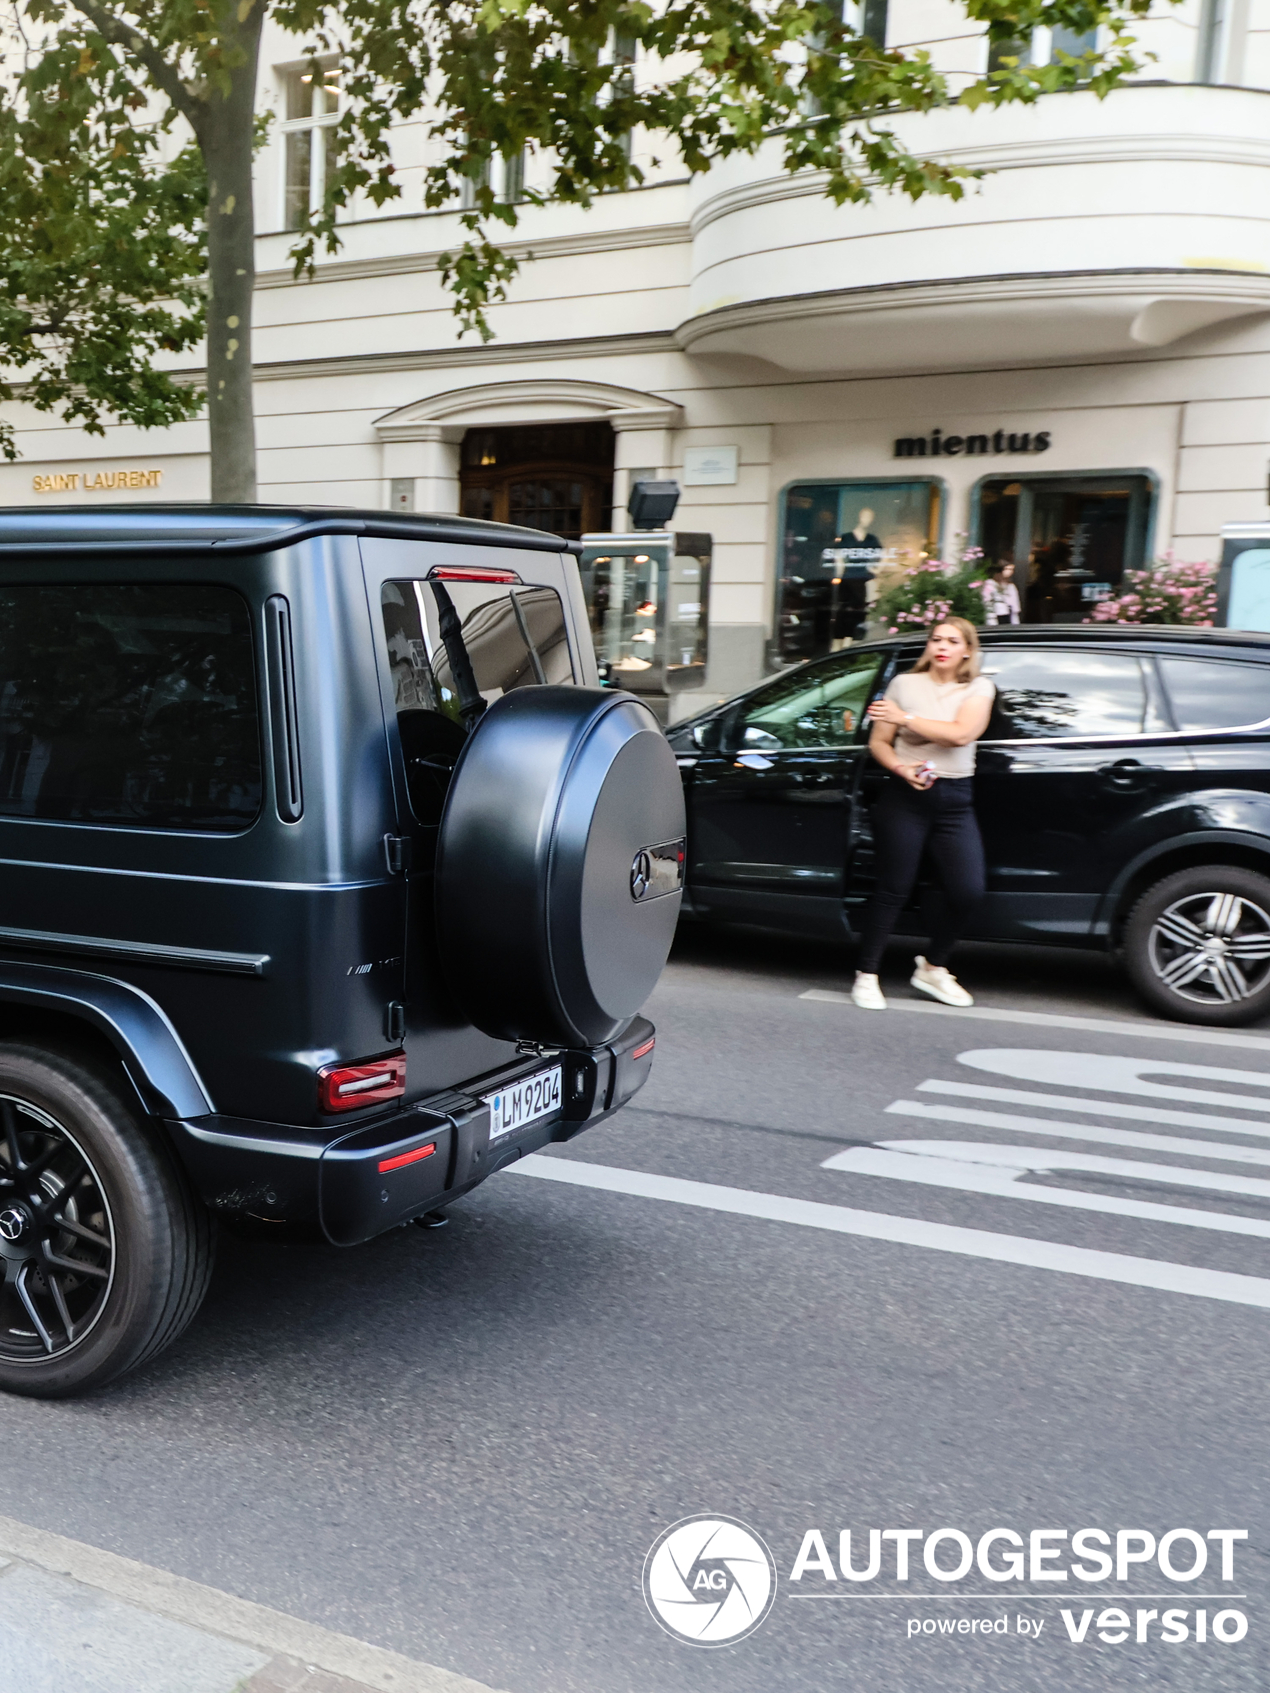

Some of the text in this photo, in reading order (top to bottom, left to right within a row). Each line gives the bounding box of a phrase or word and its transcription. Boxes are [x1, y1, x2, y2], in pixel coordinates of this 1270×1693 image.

[895, 428, 1051, 457] mientus
[33, 470, 162, 492] SAINT LAURENT
